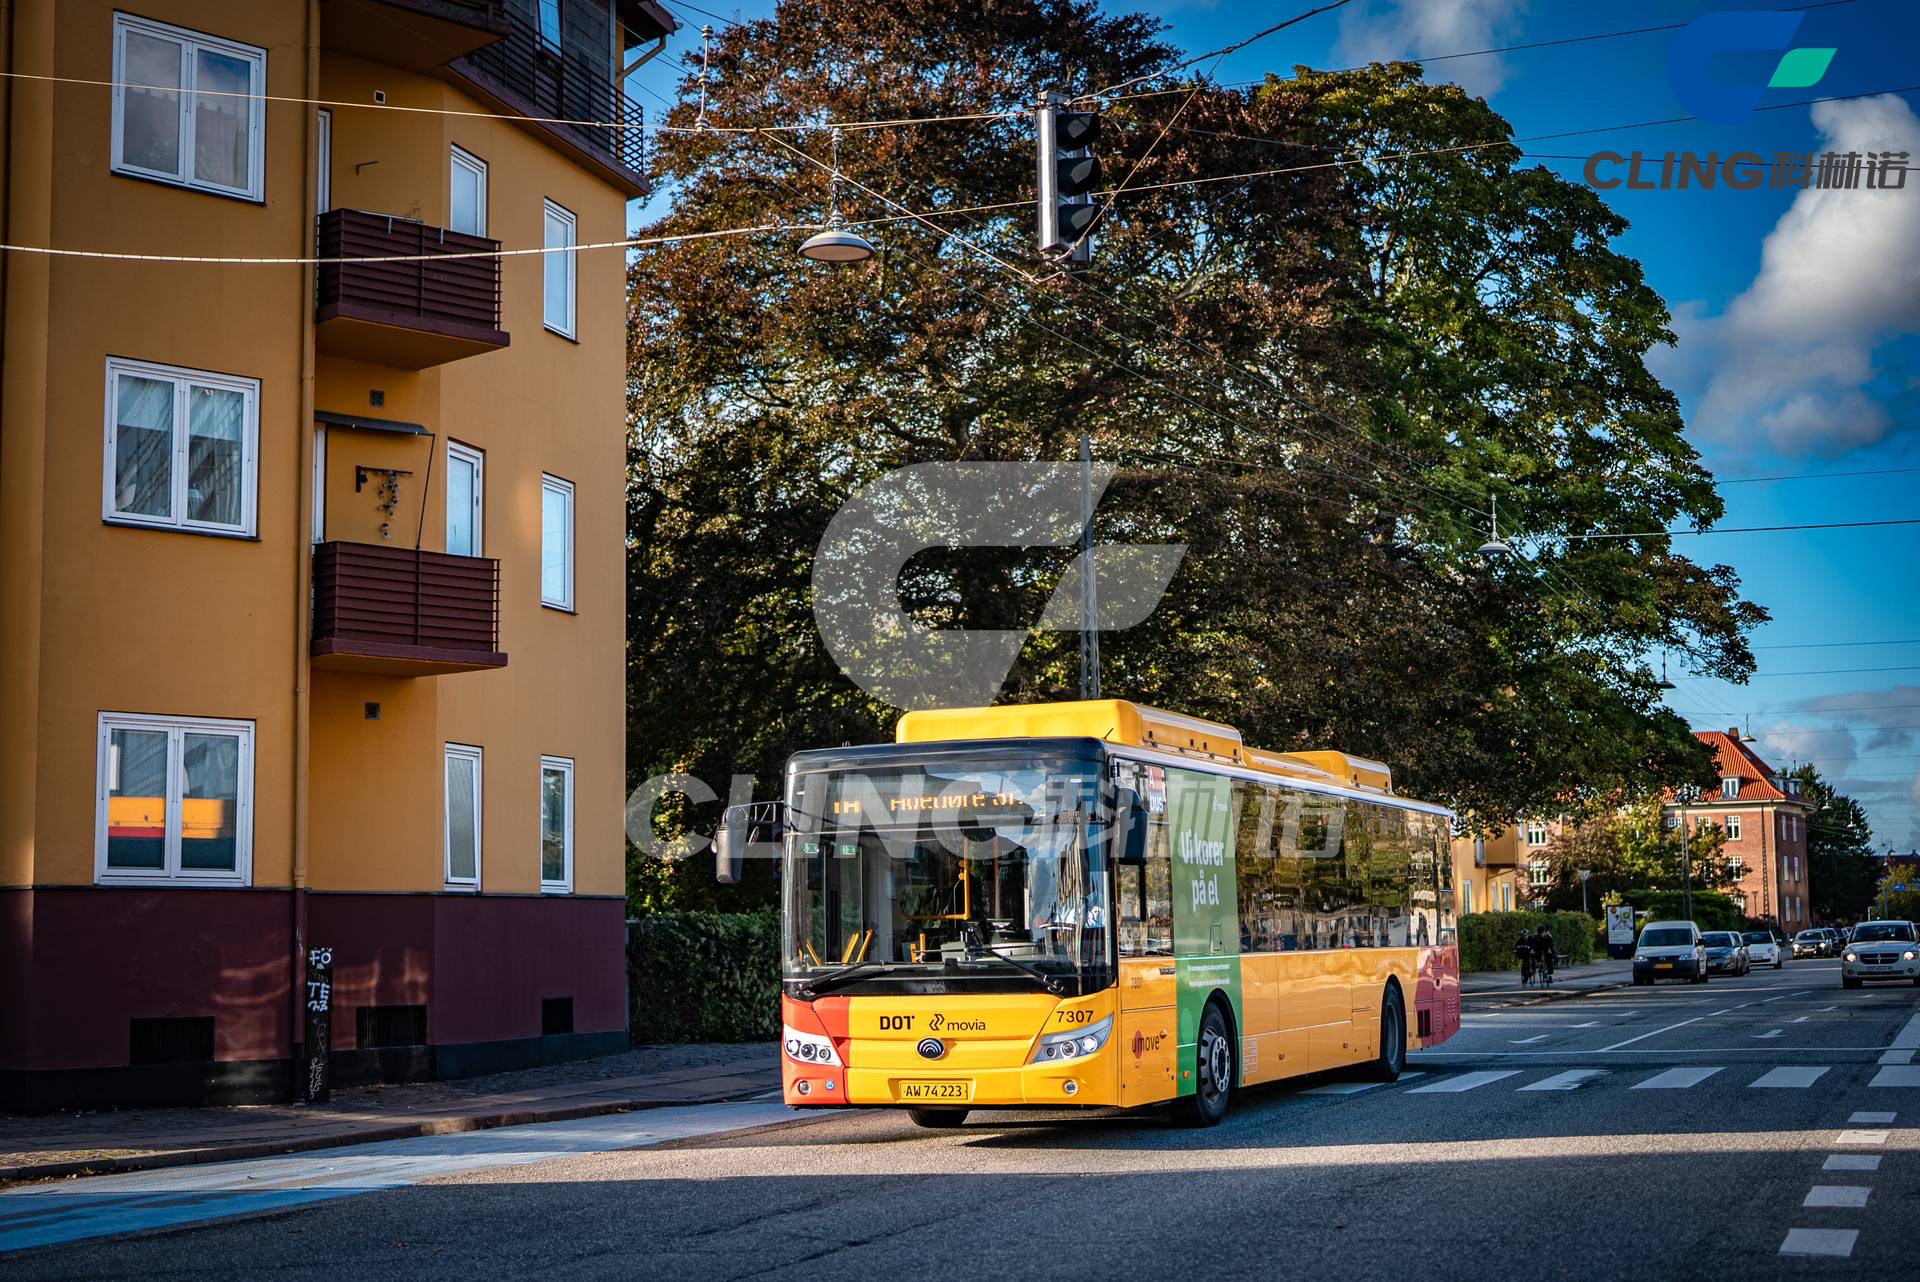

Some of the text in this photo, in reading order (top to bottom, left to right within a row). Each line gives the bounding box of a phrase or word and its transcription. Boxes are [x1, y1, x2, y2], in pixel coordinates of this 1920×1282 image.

[1192, 869, 1219, 912] på el
[879, 1015, 914, 1030] DOT
[1056, 1010, 1094, 1023] 7307
[947, 1018, 986, 1031] movia
[905, 1083, 921, 1098] AW
